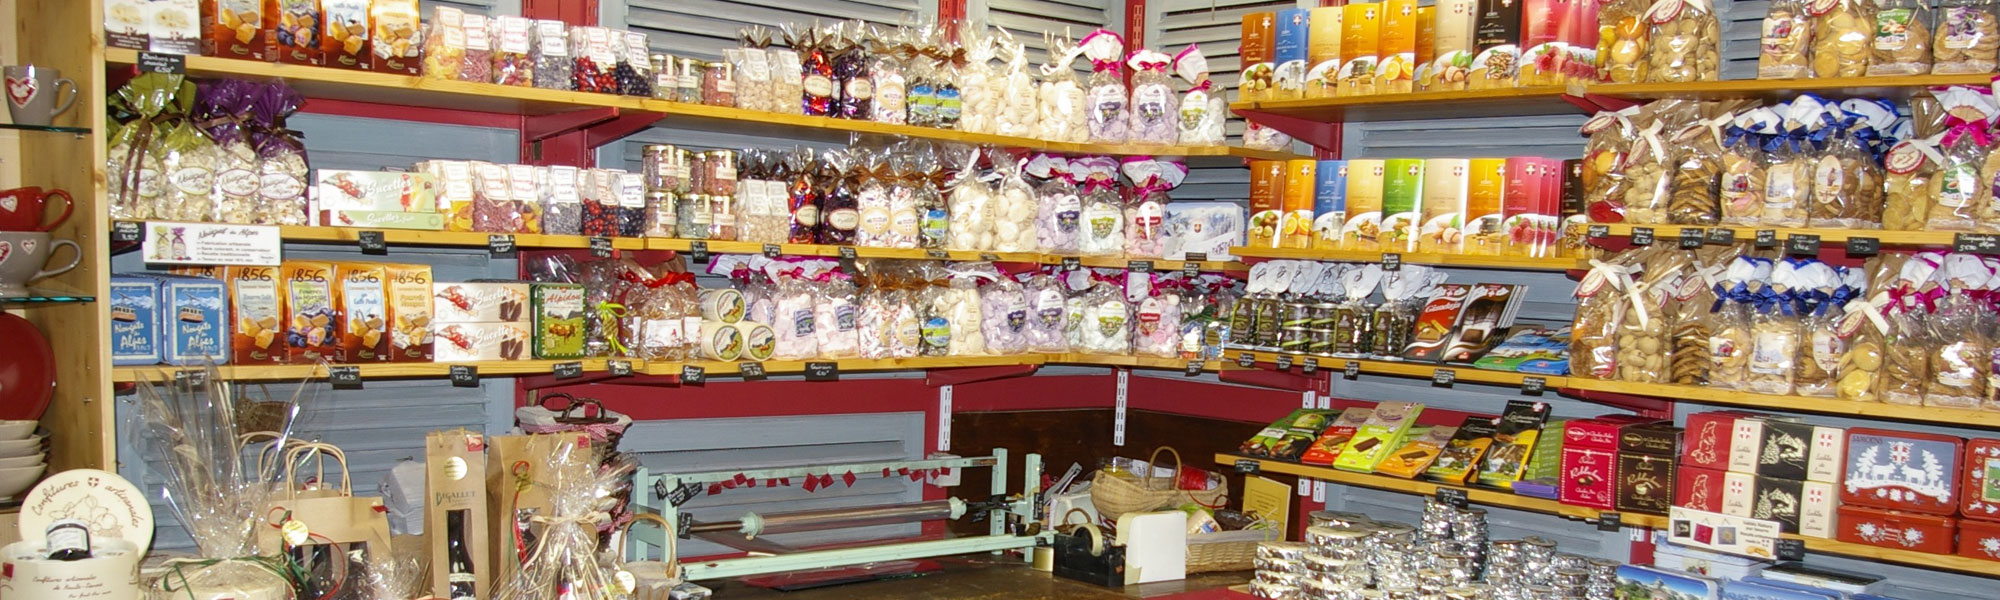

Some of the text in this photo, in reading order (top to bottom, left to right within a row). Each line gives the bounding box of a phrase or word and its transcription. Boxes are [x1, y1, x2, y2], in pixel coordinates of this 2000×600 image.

[237, 267, 272, 281] 1856
[292, 268, 327, 282] 1856
[347, 269, 379, 284] 1856
[393, 271, 426, 284] 1856
[1424, 301, 1460, 313] Gianduja
[120, 334, 147, 350] Alpes
[188, 336, 215, 351] Alpes
[31, 480, 144, 529] Confitures artisanales
